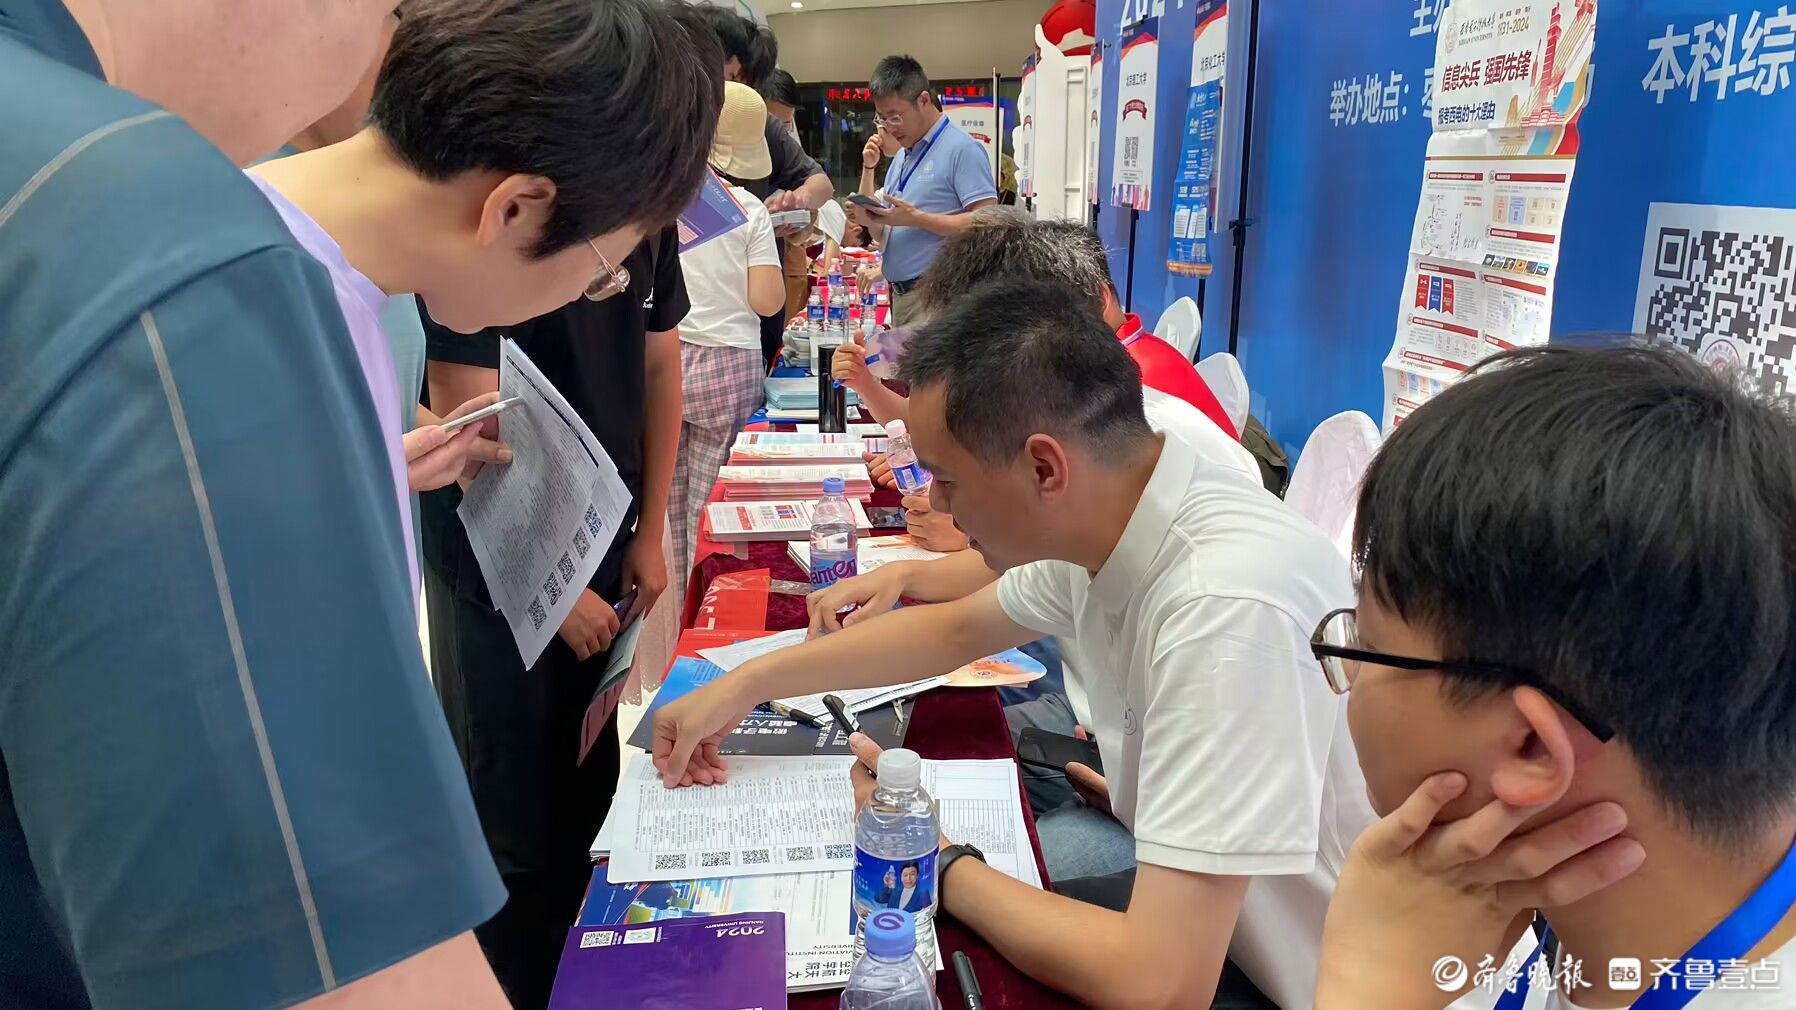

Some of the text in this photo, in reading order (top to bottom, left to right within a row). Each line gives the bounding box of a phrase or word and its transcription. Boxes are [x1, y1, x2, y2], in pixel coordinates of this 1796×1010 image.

[1440, 50, 1533, 92] 信息尖兵 强国先锋
[1641, 4, 1796, 104] 本科综
[1438, 99, 1496, 126] 报考西电的十大理由
[716, 925, 765, 938] 2024
